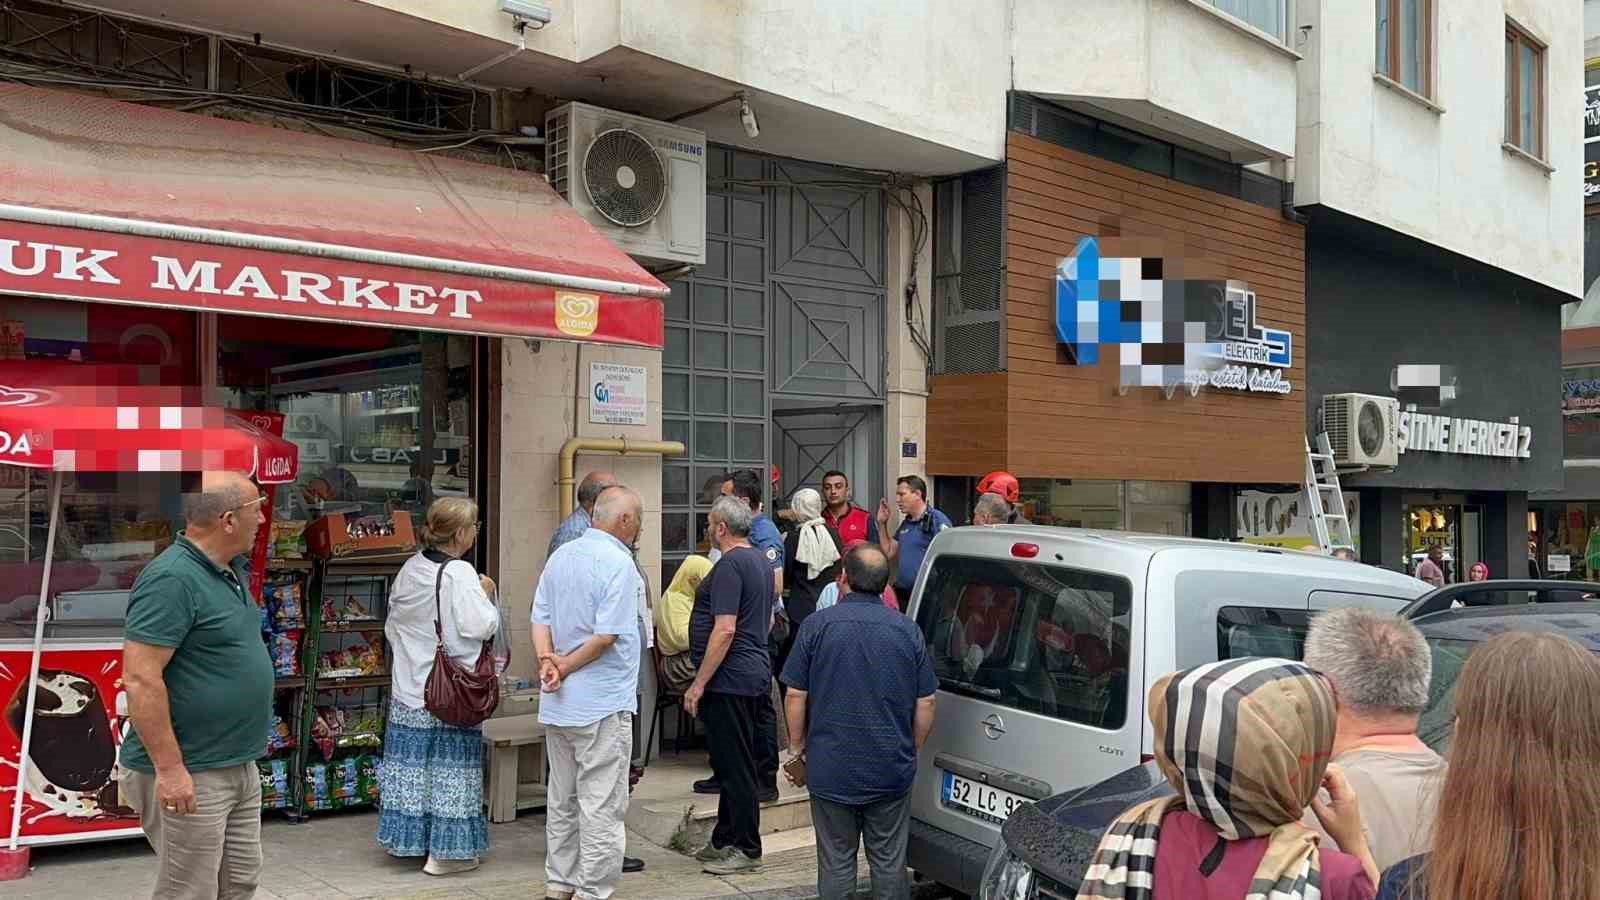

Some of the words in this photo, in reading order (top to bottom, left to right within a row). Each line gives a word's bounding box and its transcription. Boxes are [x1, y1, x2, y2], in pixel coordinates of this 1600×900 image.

[151, 256, 483, 318] MARKET
[1398, 403, 1450, 453] ŞİTME
[1454, 416, 1520, 456] MERKEZİ
[1518, 426, 1531, 457] 2
[953, 779, 971, 803] 52
[978, 787, 997, 811] LC
